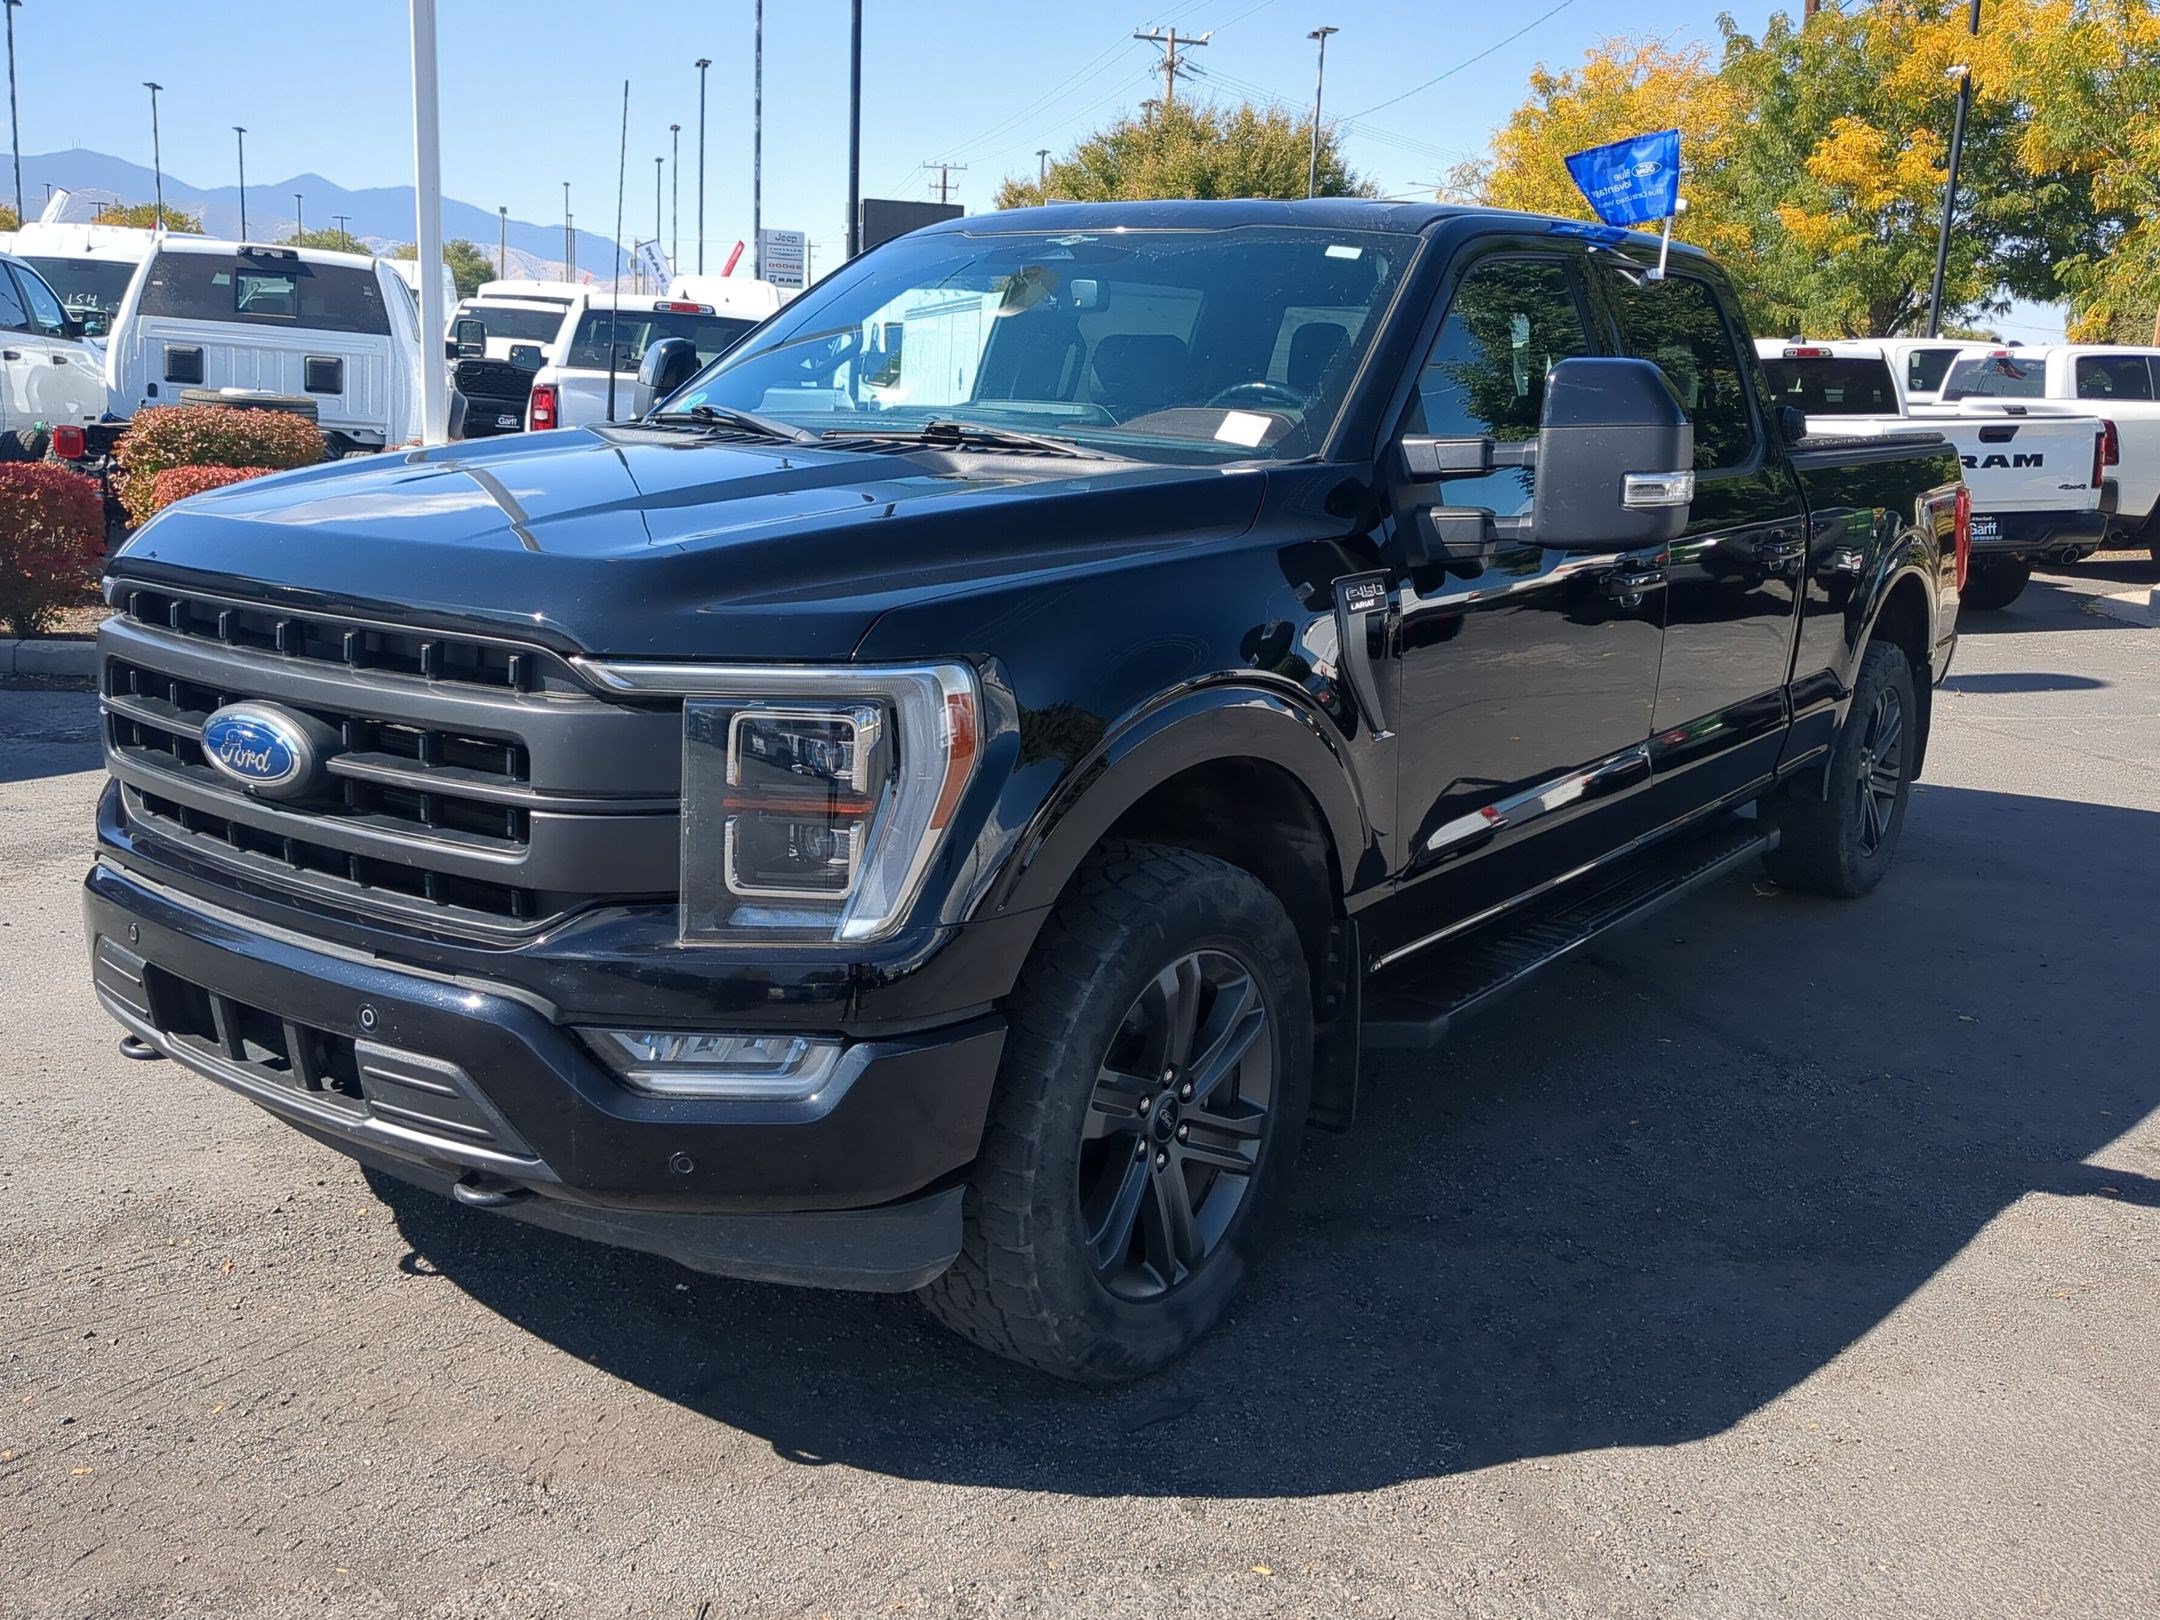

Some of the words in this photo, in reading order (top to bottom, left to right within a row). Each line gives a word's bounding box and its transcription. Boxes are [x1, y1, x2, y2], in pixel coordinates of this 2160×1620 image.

[775, 233, 798, 243] Jeep
[768, 262, 803, 270] DODGE
[1960, 454, 2044, 469] RAM
[1969, 522, 1997, 535] Garff
[1350, 599, 1375, 610] LARIAT
[219, 728, 272, 773] Ford
